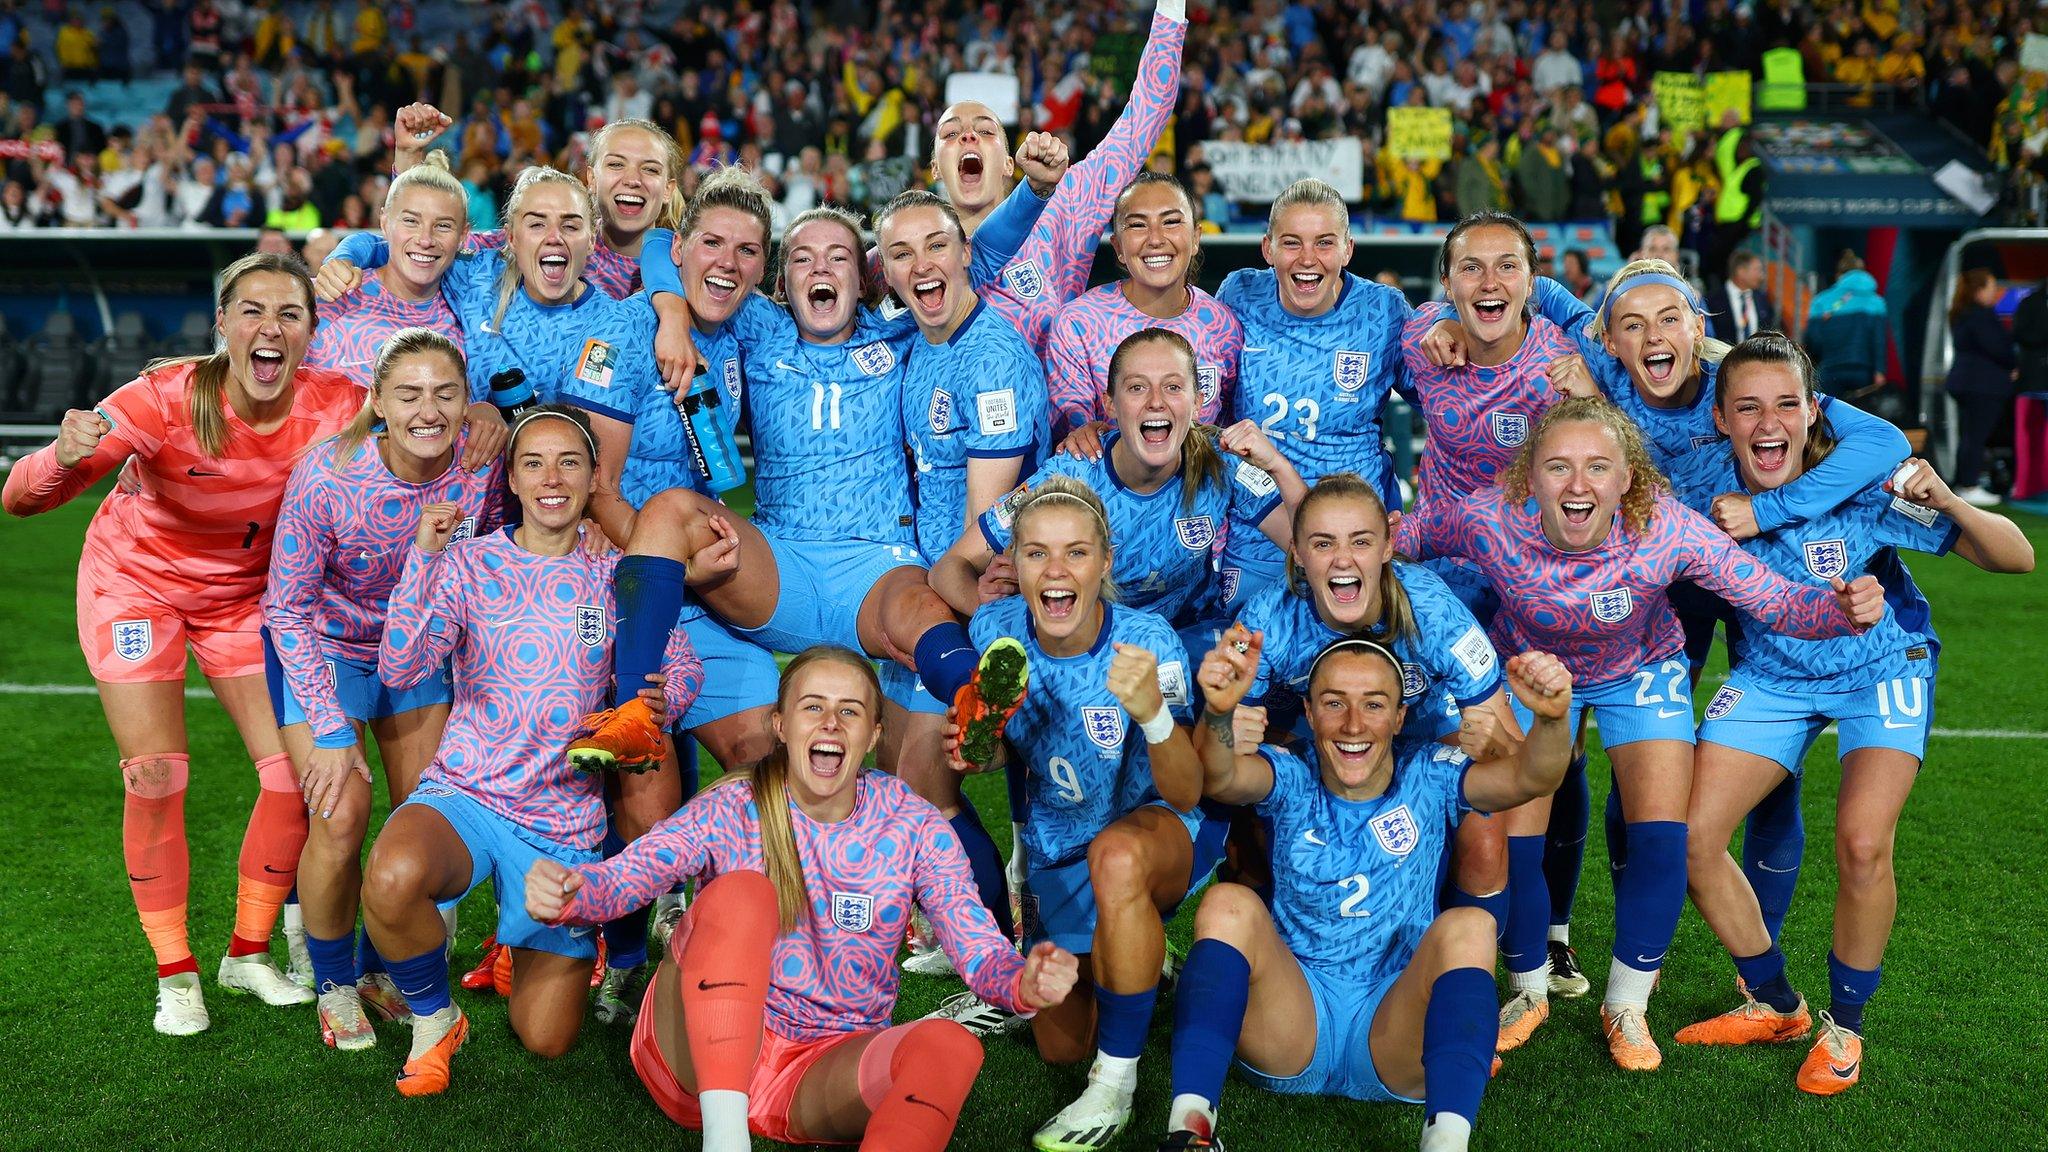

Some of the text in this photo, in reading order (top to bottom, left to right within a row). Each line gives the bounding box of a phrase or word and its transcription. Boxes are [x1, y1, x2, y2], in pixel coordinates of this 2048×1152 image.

[1845, 198, 1899, 214] WORLD
[1902, 198, 1933, 214] CUP
[811, 381, 842, 430] 11
[986, 403, 1008, 413] UNITES
[1262, 392, 1319, 442] 23
[677, 403, 709, 477] POWERADE
[241, 521, 260, 549] 1
[1466, 640, 1484, 659] UNITES
[1631, 660, 1689, 706] 22
[1876, 677, 1922, 717] 10
[1049, 756, 1083, 803] 9
[1338, 873, 1371, 917] 2
